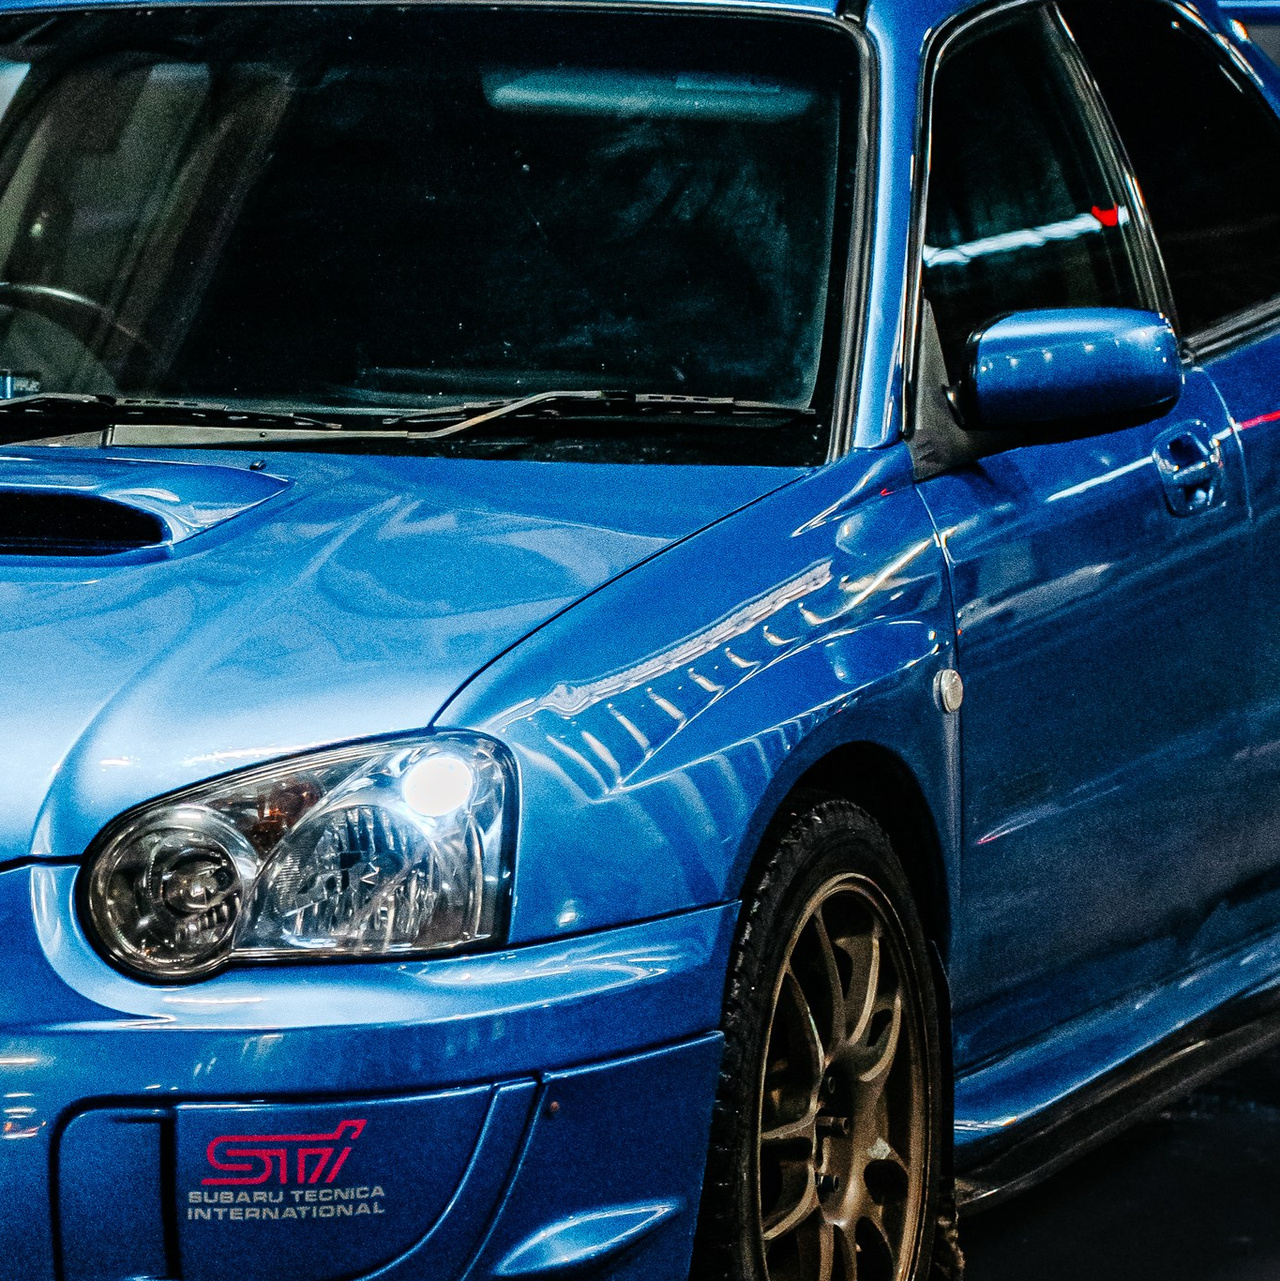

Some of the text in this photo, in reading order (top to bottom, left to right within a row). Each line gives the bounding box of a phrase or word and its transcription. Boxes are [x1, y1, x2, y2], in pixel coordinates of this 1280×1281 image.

[188, 1185, 386, 1203] SUBARU TECNICA
[187, 1203, 385, 1220] INTERNATIONAL
